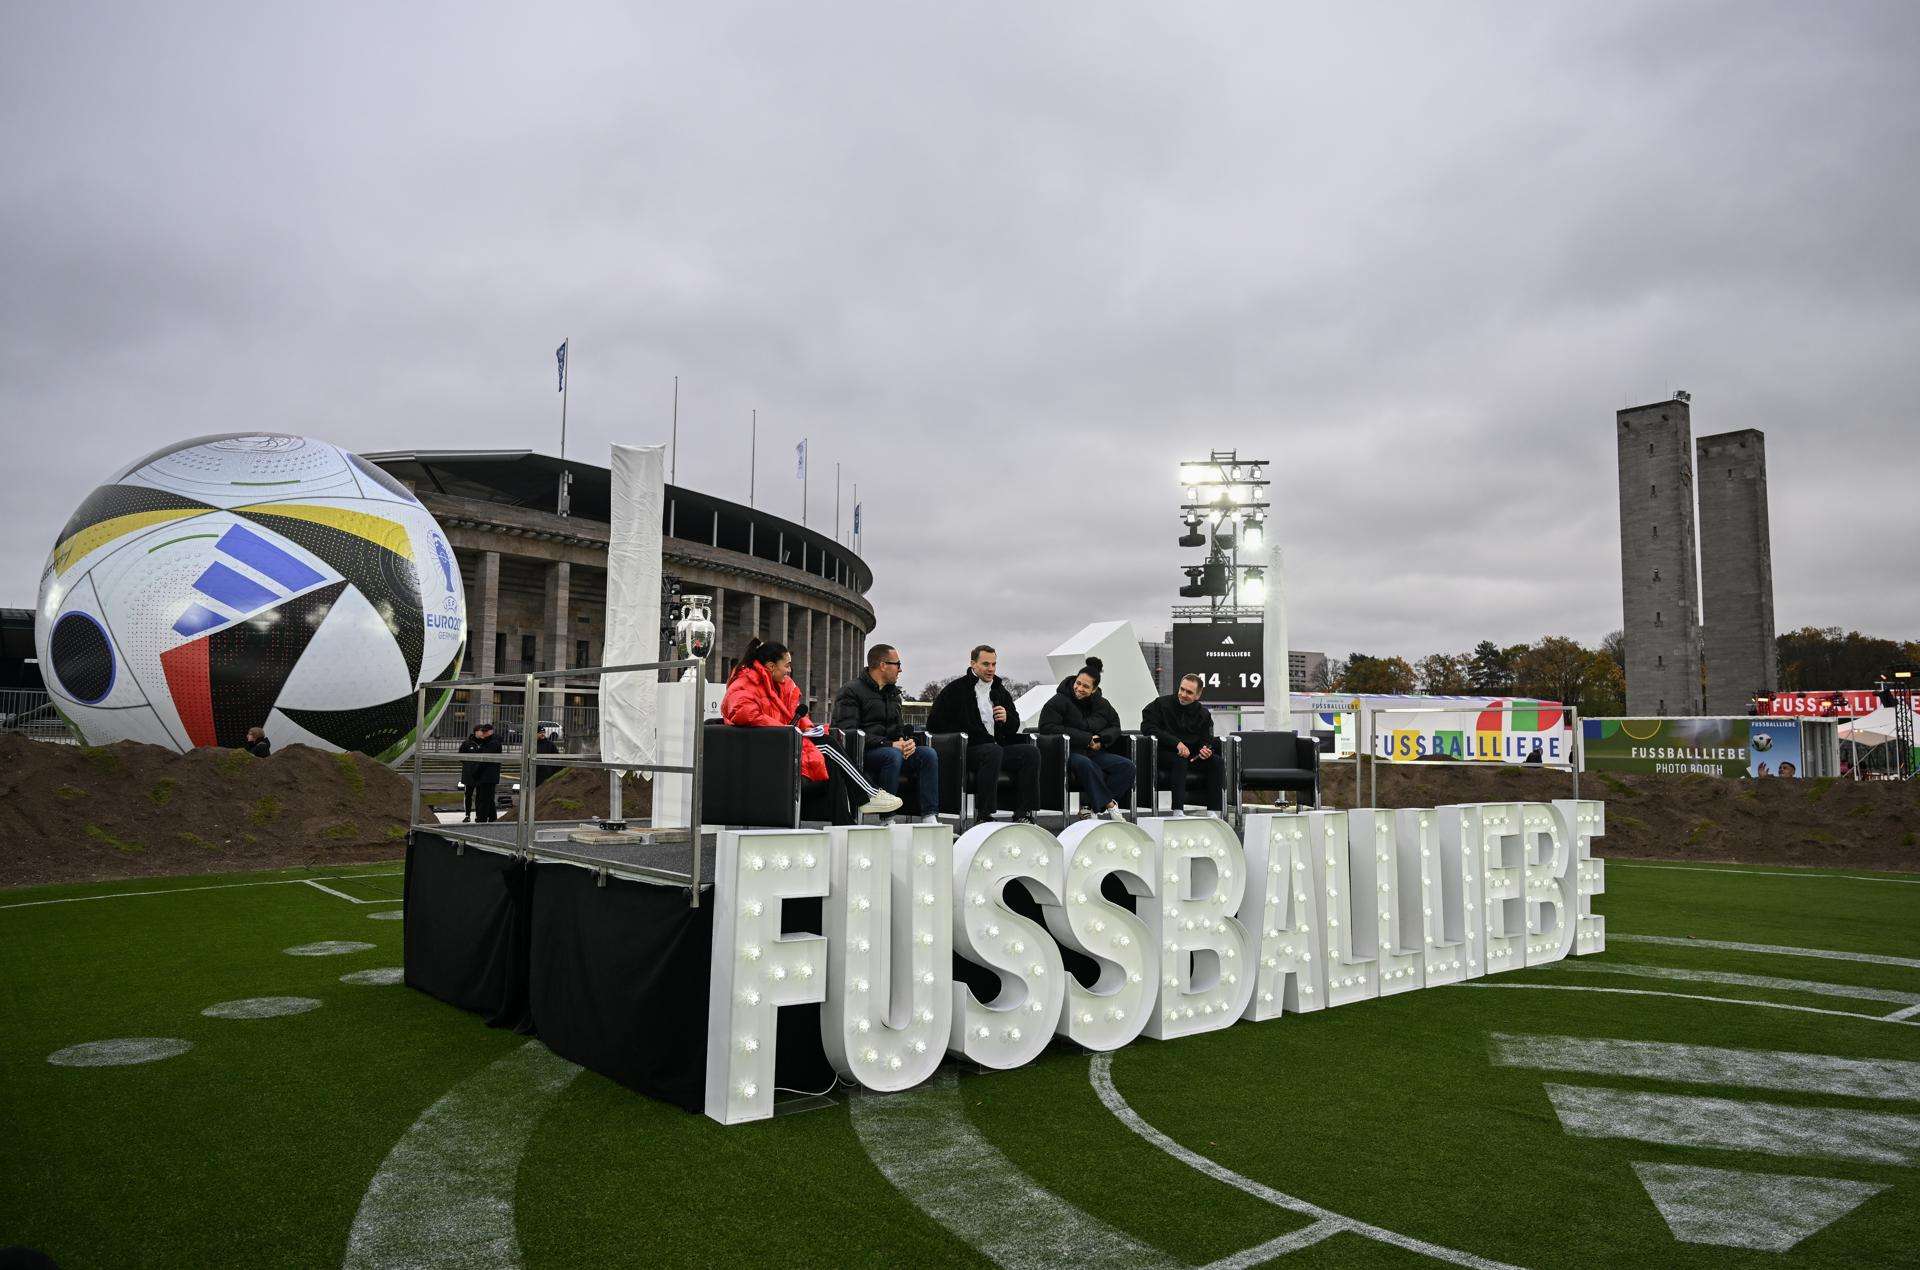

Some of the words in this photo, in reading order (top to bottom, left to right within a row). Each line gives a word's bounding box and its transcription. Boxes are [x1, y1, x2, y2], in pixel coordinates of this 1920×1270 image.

[1198, 673, 1221, 688] 14
[1238, 673, 1262, 688] 19
[1631, 747, 1746, 760] FUSSBALLLIEBE
[1656, 763, 1687, 774] PHOTO
[1690, 764, 1723, 775] BOOTH
[704, 799, 1606, 1126] FUSSBALLLIEBE
